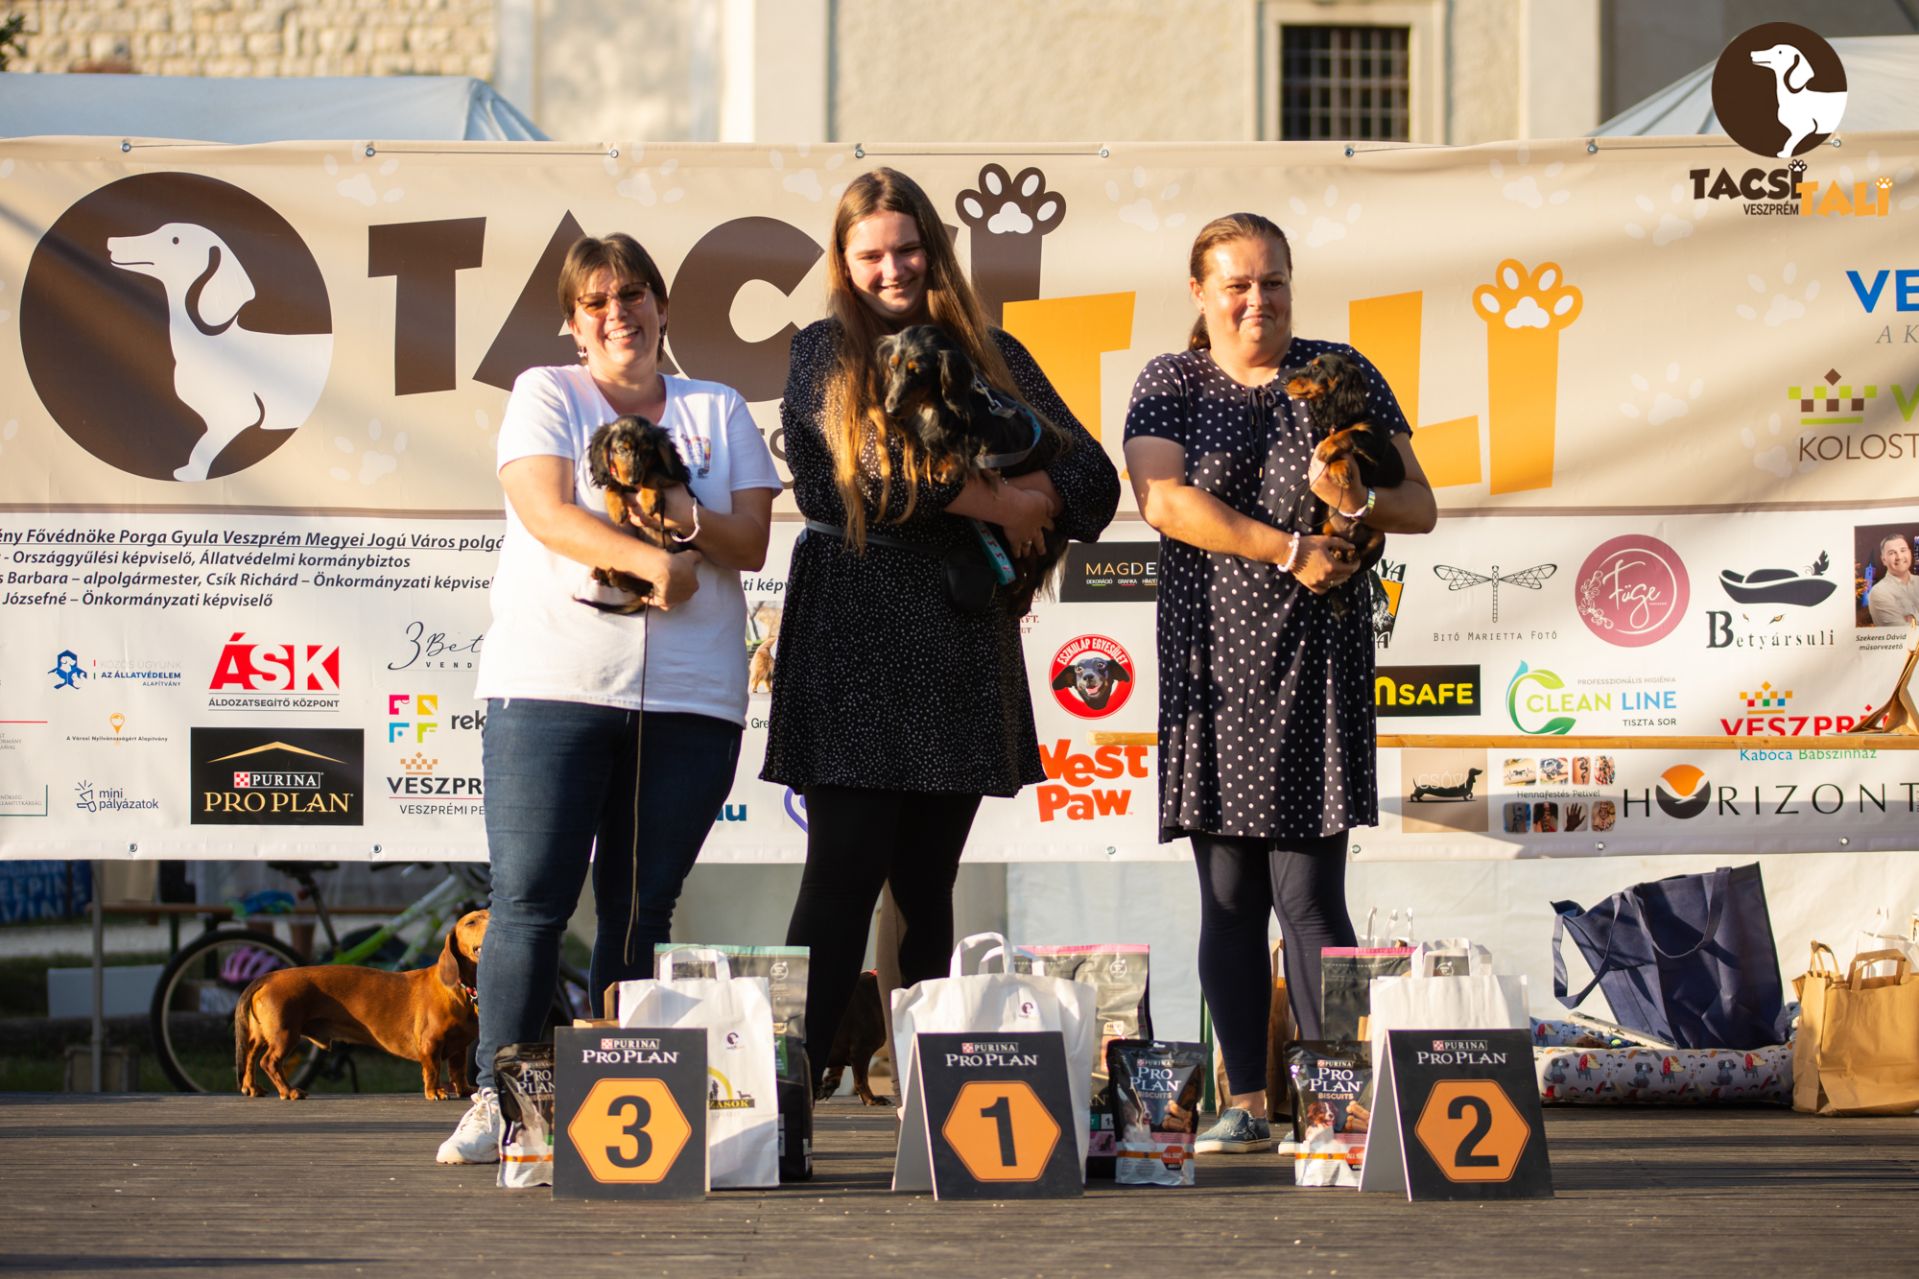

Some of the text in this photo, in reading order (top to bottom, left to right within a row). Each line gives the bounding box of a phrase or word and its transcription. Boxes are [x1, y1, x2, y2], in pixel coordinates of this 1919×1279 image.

[1876, 325, 1892, 344] A
[27, 528, 115, 544] Fővédnöke
[119, 530, 167, 547] Porga
[171, 530, 218, 547] Gyula
[223, 530, 300, 549] Veszprém
[305, 532, 364, 550] Megyei
[367, 532, 406, 550] Jogú
[411, 533, 455, 548] Város
[13, 550, 119, 567] Országgyűlési
[122, 550, 196, 568] képviselő,
[200, 549, 294, 566] Állatvédelmi
[299, 552, 411, 570] kormánybiztos
[1086, 562, 1157, 576] MAGDE
[7, 572, 68, 585] Barbara
[83, 572, 202, 588] alpolgármester,
[206, 572, 236, 586] Csík
[240, 573, 299, 587] Richárd
[313, 571, 431, 591] Önkormányzati
[2, 591, 67, 605] Józsefné
[82, 590, 199, 609] Önkormányzati
[203, 592, 273, 610] képviselő
[1467, 632, 1523, 641] MARIETTA
[1706, 611, 1834, 650] Betyársuli
[209, 632, 340, 691] ÁSK
[101, 670, 181, 679] AZ ÁLLATVÉDELEM
[208, 697, 340, 708] ÁLDOZATSEGÍTŐ KÖZPONT
[1526, 691, 1677, 713] CLEAN LINE
[1623, 718, 1677, 727] TISZTA SOR
[252, 774, 317, 787] PURINA
[99, 787, 123, 799] mini
[99, 798, 159, 812] pályázatok
[204, 791, 350, 813] PRO PLAN
[400, 803, 467, 815] VESZPRÉMI
[1037, 785, 1131, 822] Paw
[612, 1039, 658, 1049] PURINA
[974, 1043, 1018, 1053] PURINA
[1444, 1040, 1486, 1050] PURINA
[581, 1051, 678, 1063] PRO PLAN
[945, 1053, 1038, 1067] PRO PLAN
[1417, 1051, 1507, 1065] PRO PLAN
[523, 1070, 551, 1081] PRO
[1137, 1067, 1173, 1080] PRO
[1318, 1067, 1353, 1080] PRO
[1130, 1077, 1181, 1091] PLAN
[1309, 1079, 1360, 1092] PLAN
[605, 1095, 653, 1169] 3
[980, 1096, 1017, 1167] 1
[1447, 1095, 1500, 1167] 2
